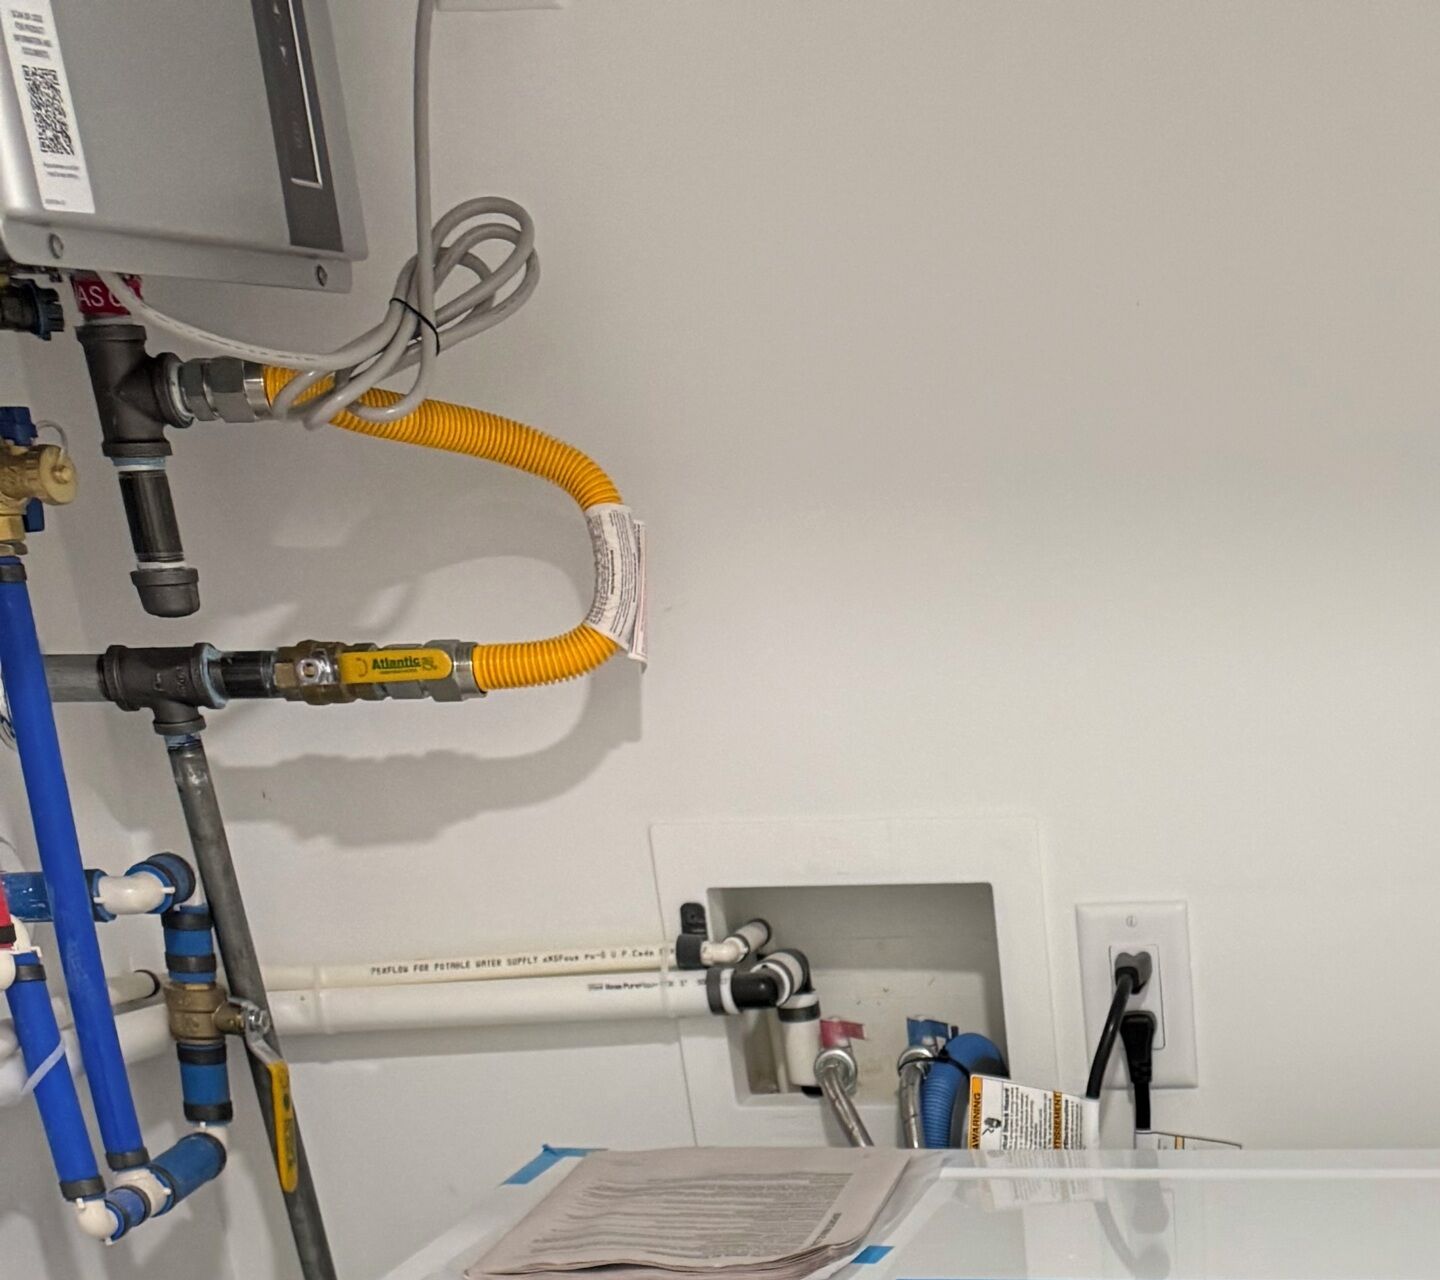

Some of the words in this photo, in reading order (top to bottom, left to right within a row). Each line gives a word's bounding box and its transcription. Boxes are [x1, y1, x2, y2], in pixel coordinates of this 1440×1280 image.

[371, 656, 421, 670] Atlantic
[413, 964, 429, 973] FOR
[434, 960, 471, 971] POTABLE
[475, 959, 502, 969] WATER
[507, 956, 538, 966] SUPPLY
